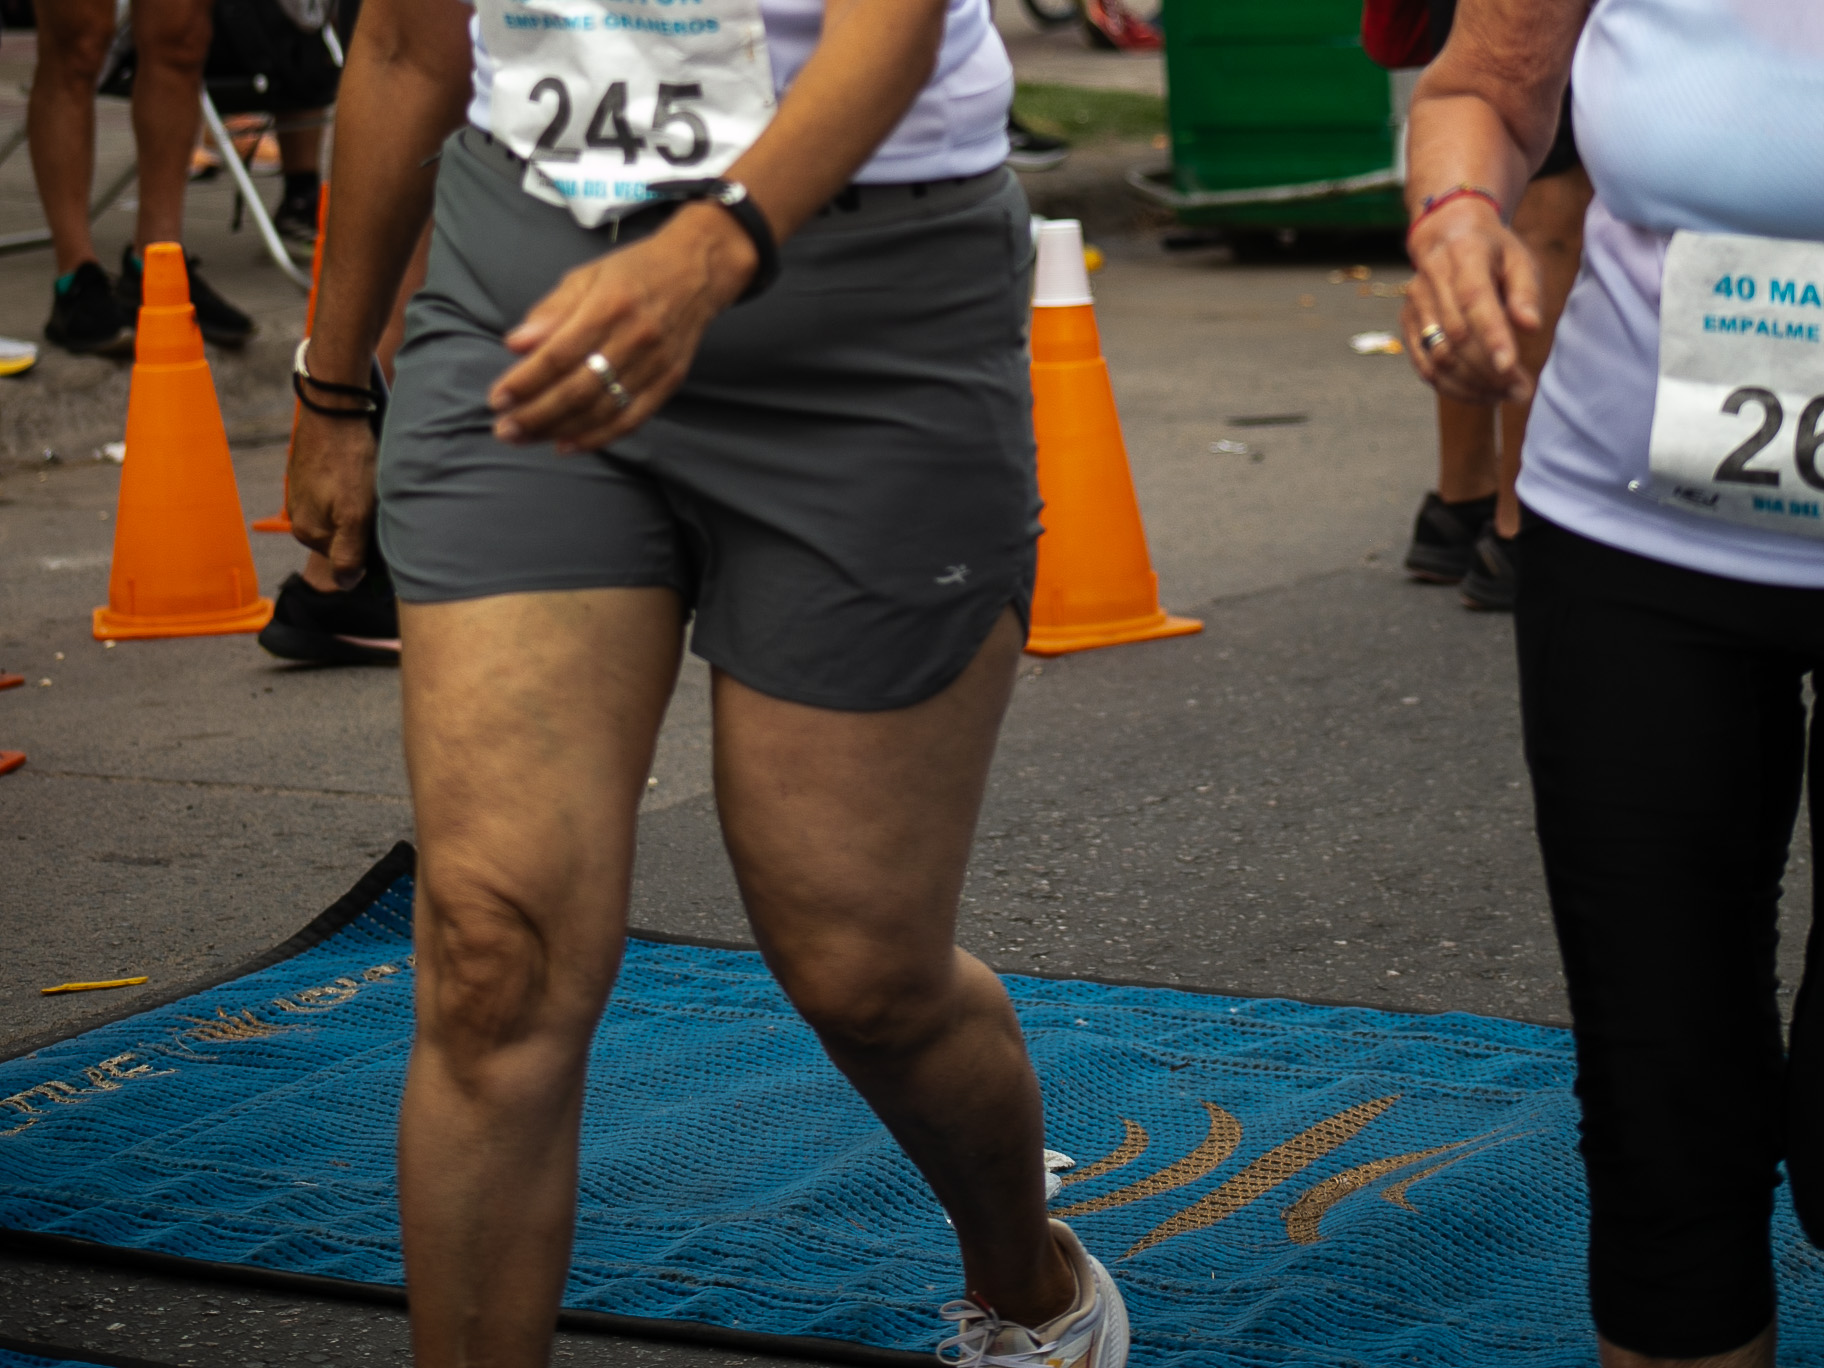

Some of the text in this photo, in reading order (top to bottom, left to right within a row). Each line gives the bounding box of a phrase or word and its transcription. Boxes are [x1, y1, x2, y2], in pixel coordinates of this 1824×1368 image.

[528, 77, 711, 167] 245
[1714, 274, 1756, 301] 40
[1702, 314, 1821, 343] EMPALME
